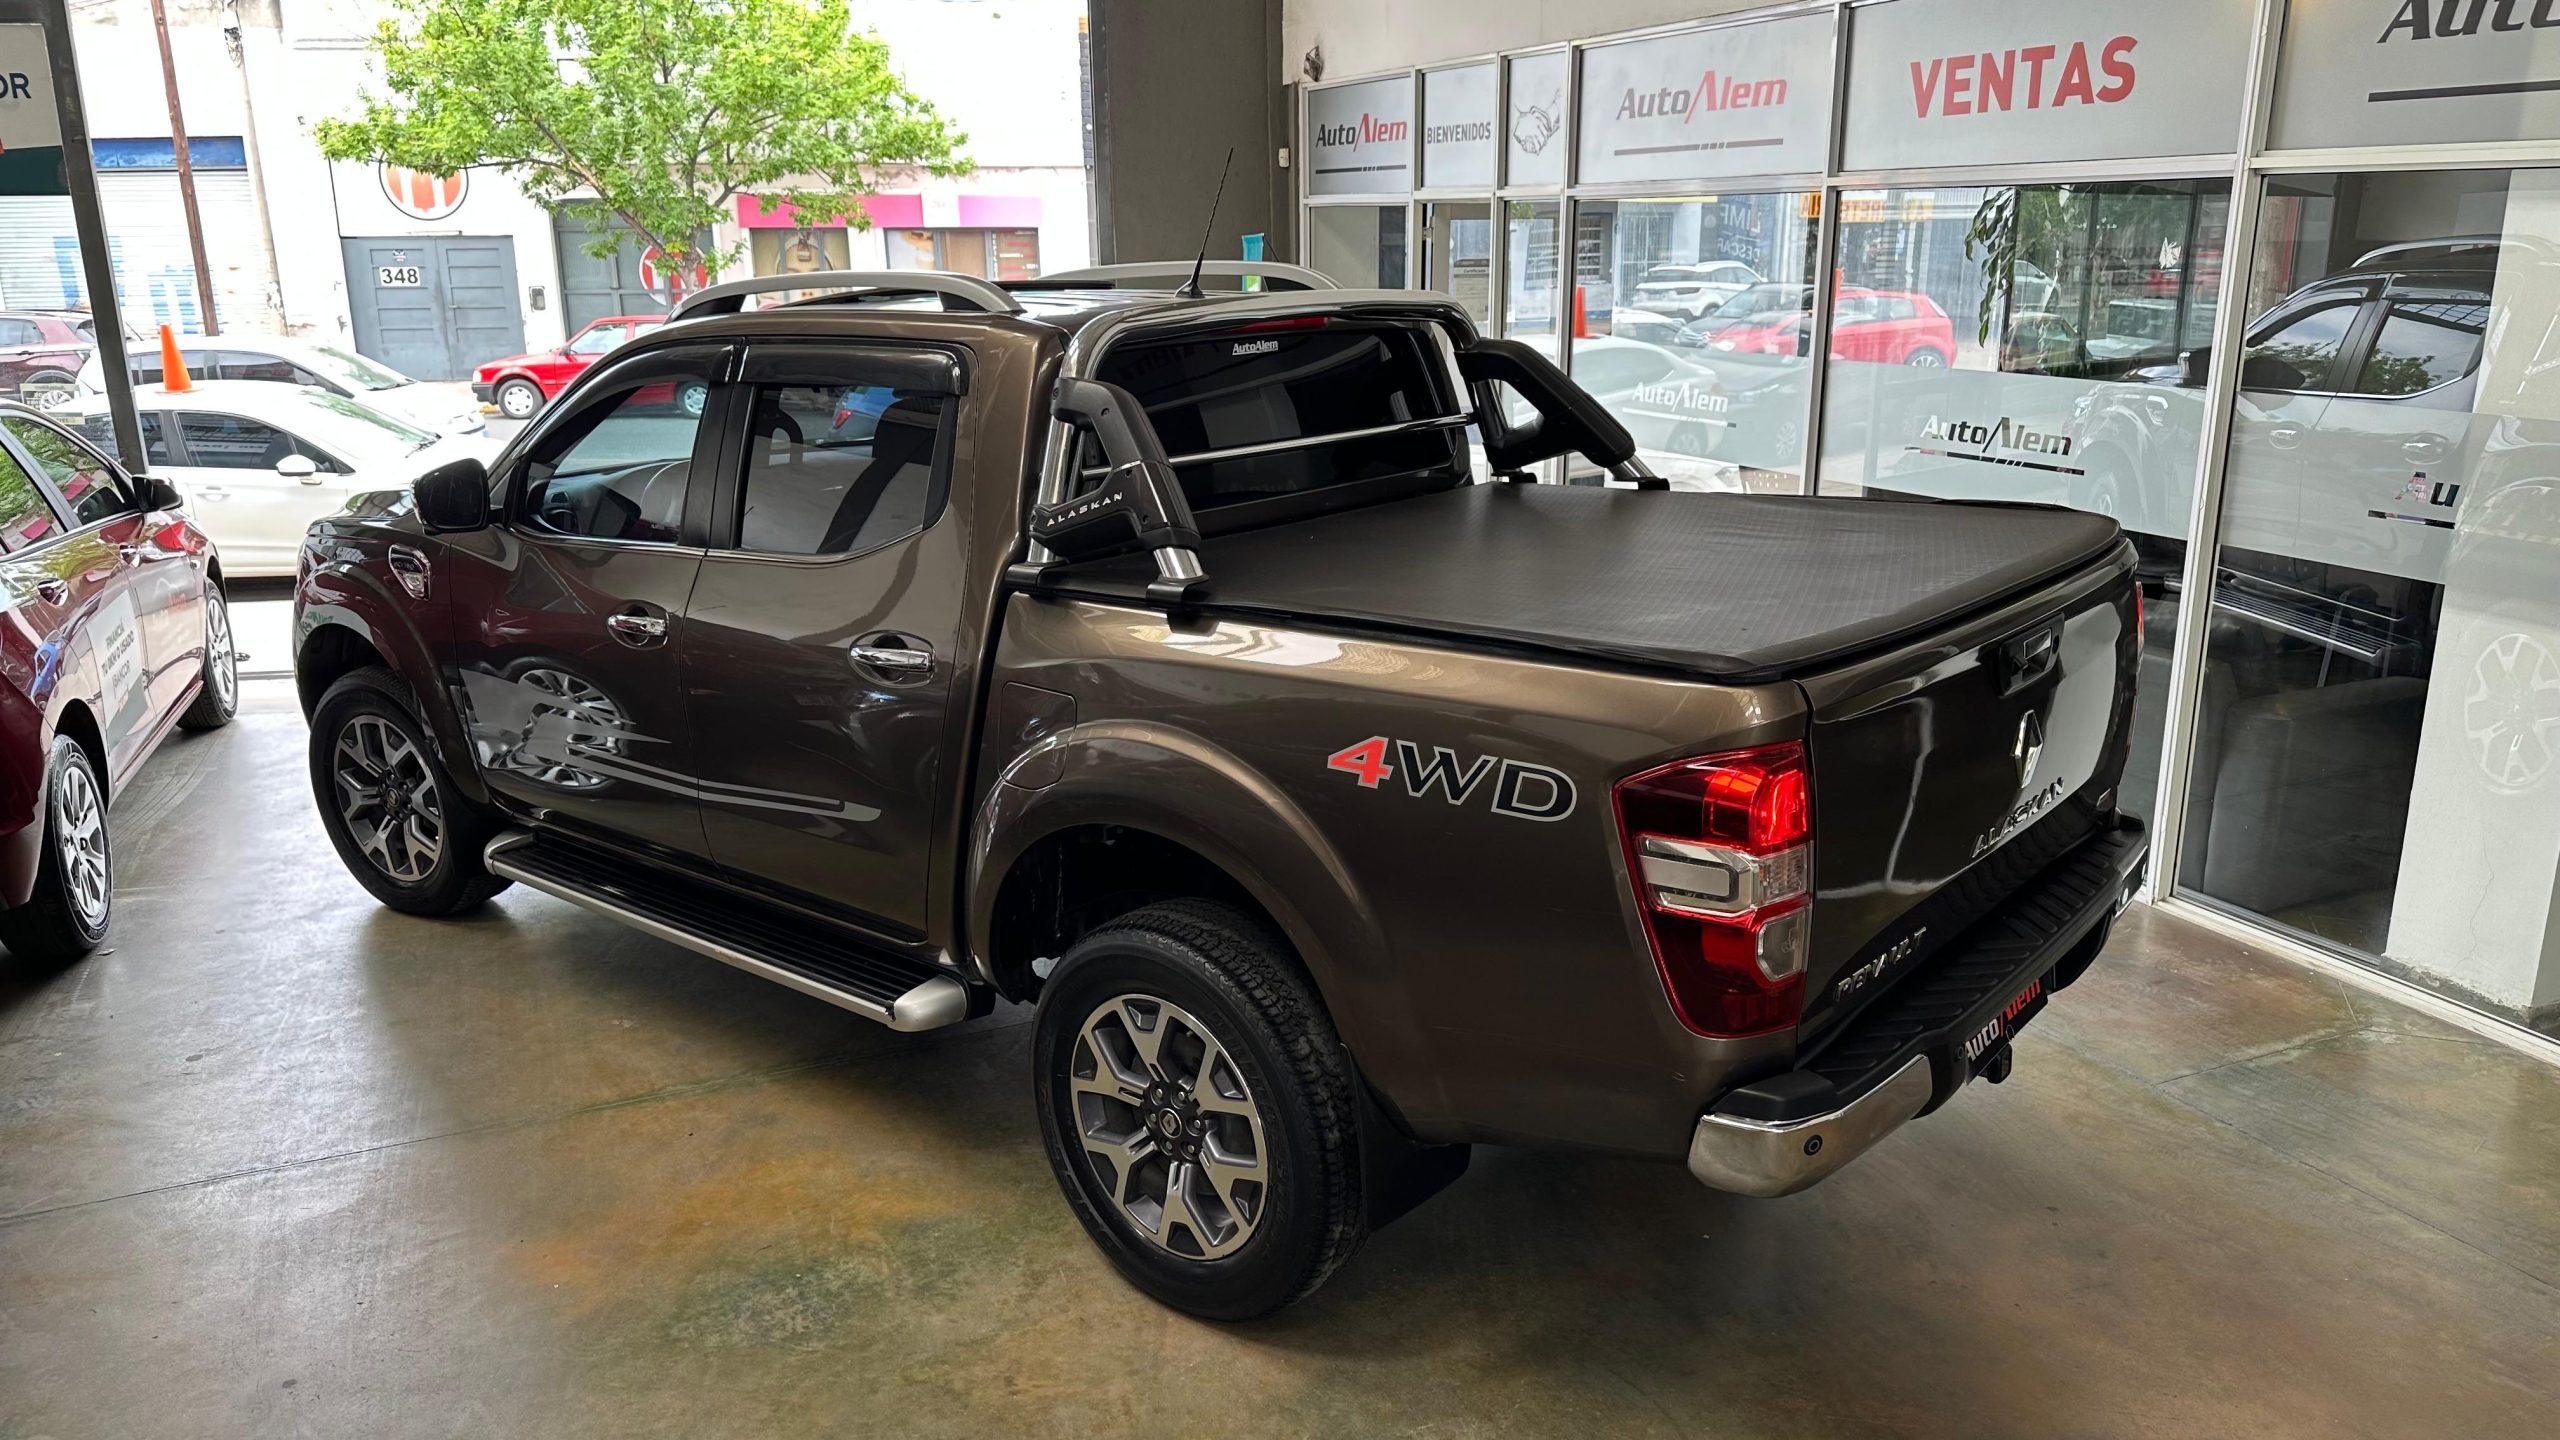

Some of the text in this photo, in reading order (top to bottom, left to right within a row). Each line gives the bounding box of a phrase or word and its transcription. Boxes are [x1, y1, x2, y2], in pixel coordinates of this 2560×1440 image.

[1910, 35, 2138, 118] VENTAS
[1426, 121, 1492, 145] BIENVENIDOS
[382, 268, 418, 284] 348
[1047, 492, 1123, 527] ALASKAN
[1327, 736, 1577, 822] 4WD
[1971, 776, 2065, 858] ALASKAN
[1833, 926, 1927, 1003] RENAULT
